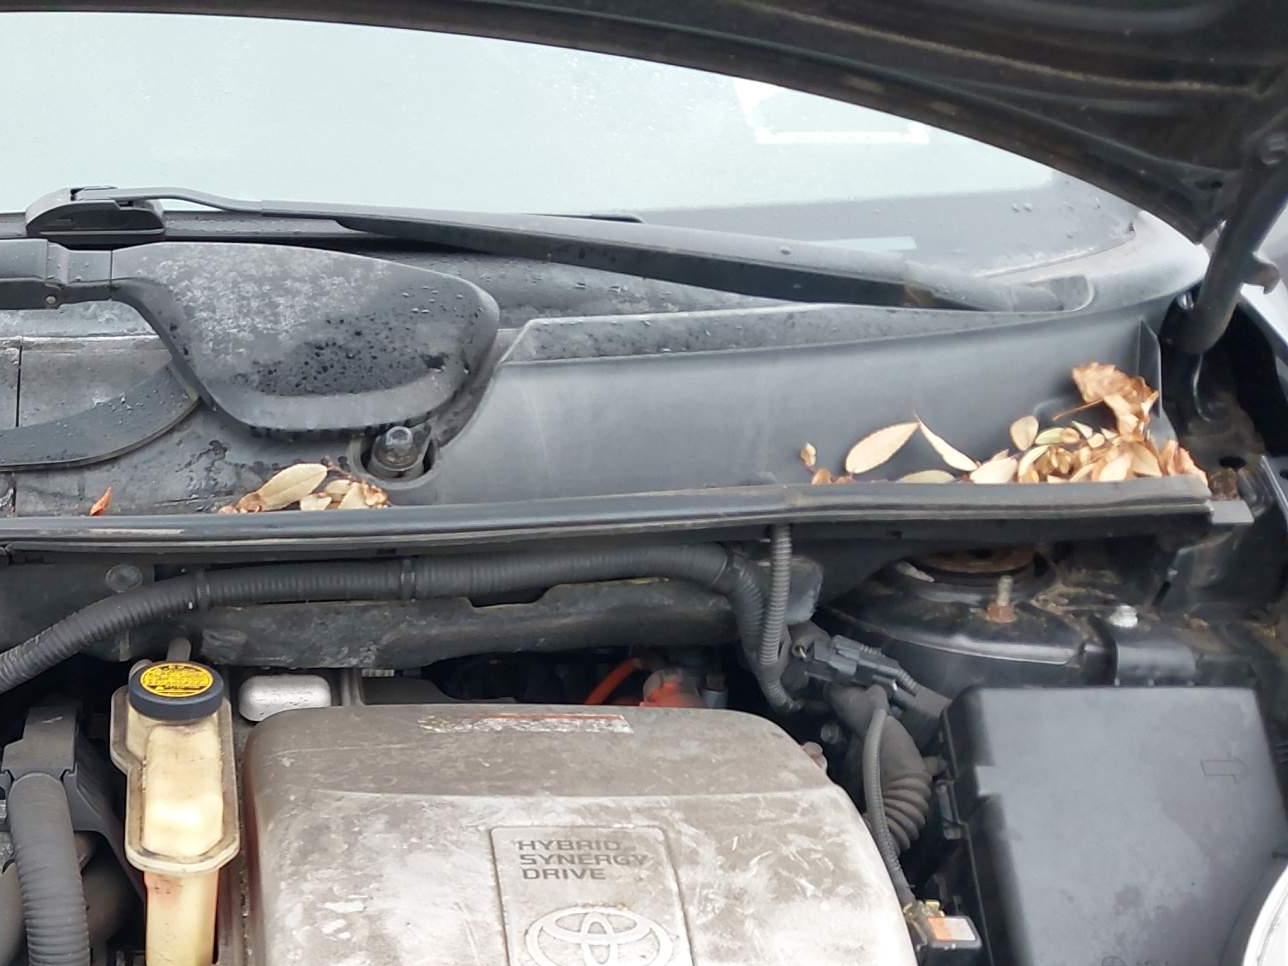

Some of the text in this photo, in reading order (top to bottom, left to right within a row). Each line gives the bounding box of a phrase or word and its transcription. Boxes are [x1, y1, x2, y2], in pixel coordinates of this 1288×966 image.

[517, 839, 621, 851] HYBRID
[520, 854, 649, 866] SYNERGY
[522, 868, 606, 880] DRIVE
